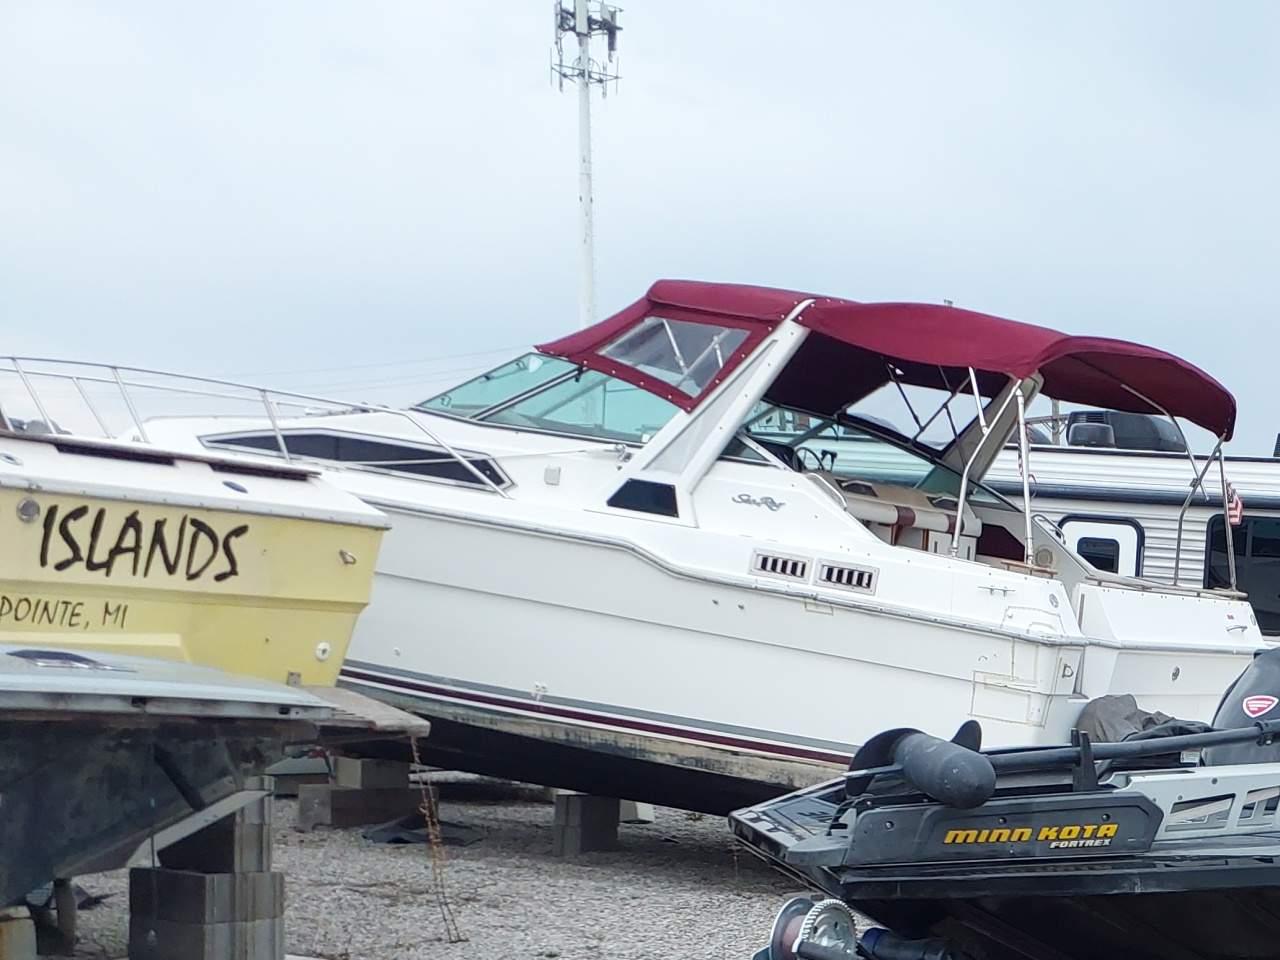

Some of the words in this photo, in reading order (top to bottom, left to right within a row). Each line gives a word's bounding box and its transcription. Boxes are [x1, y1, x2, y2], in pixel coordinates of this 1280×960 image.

[40, 504, 249, 582] ISLANDS
[102, 602, 128, 629] MI
[1037, 823, 1119, 841] KOTA
[1050, 838, 1112, 849] FORTREX
